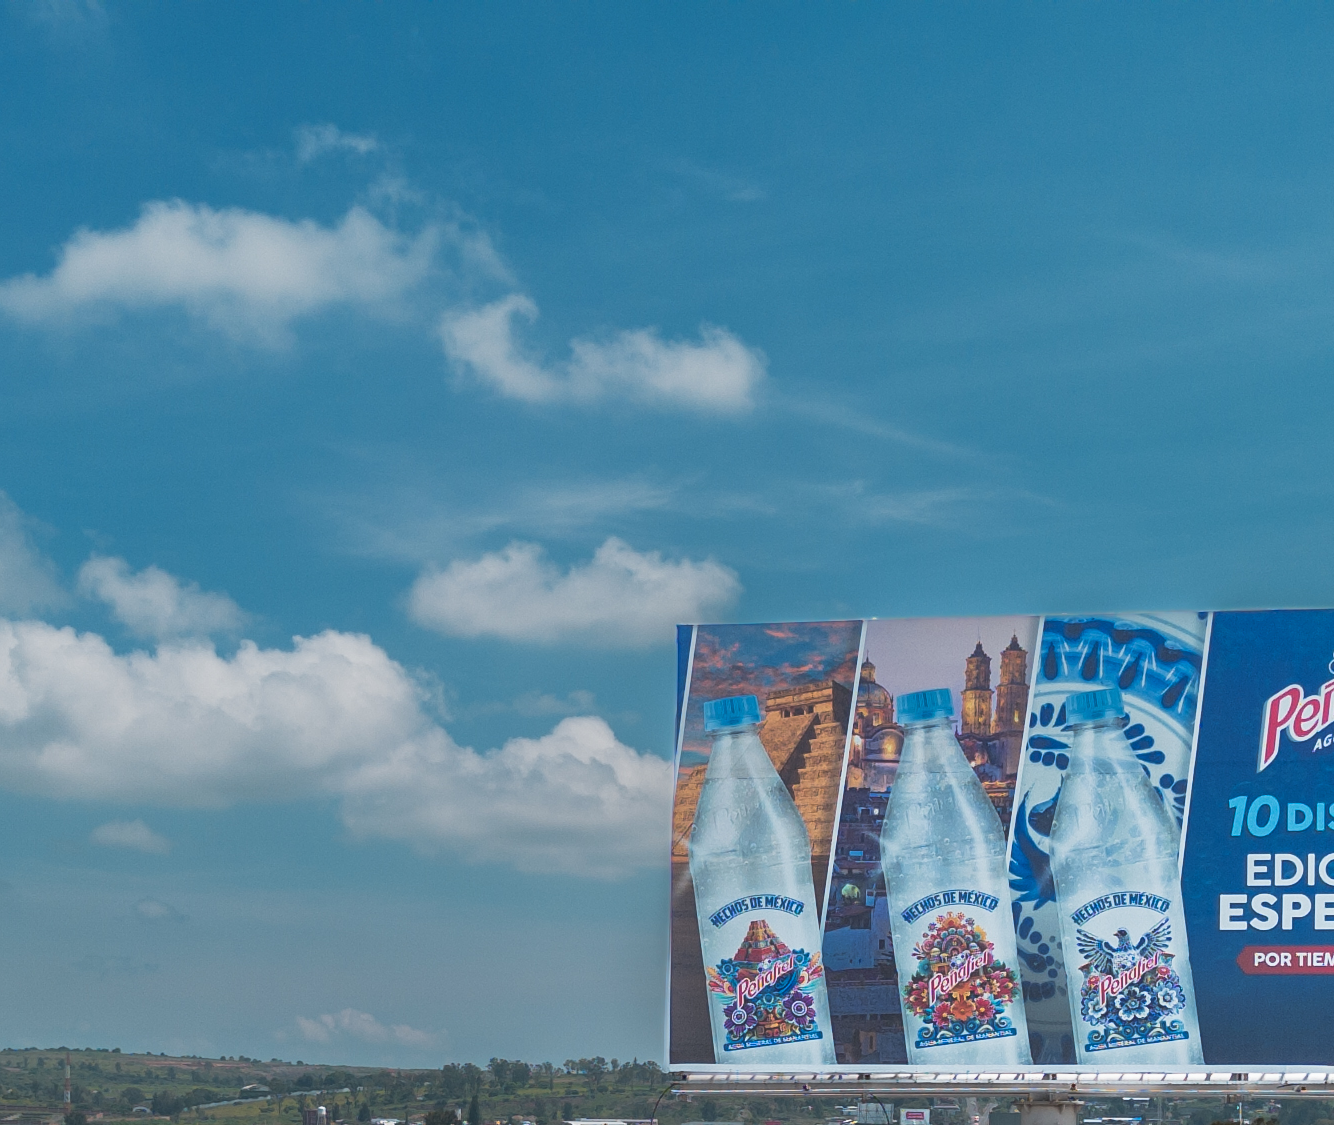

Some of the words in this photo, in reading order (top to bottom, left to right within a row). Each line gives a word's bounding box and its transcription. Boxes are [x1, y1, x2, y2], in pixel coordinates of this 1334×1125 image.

[1228, 794, 1281, 837] 10
[711, 898, 749, 927] HECHOS
[750, 896, 763, 909] DE
[764, 894, 805, 916] MÉXICO
[902, 894, 942, 923] HECHOS
[943, 892, 956, 904] DE
[958, 890, 1000, 911] MÉXICO
[1071, 897, 1112, 925] HECHOS
[1113, 894, 1127, 906] DE
[1129, 891, 1171, 913] MÉXICO
[1254, 952, 1292, 967] POR
